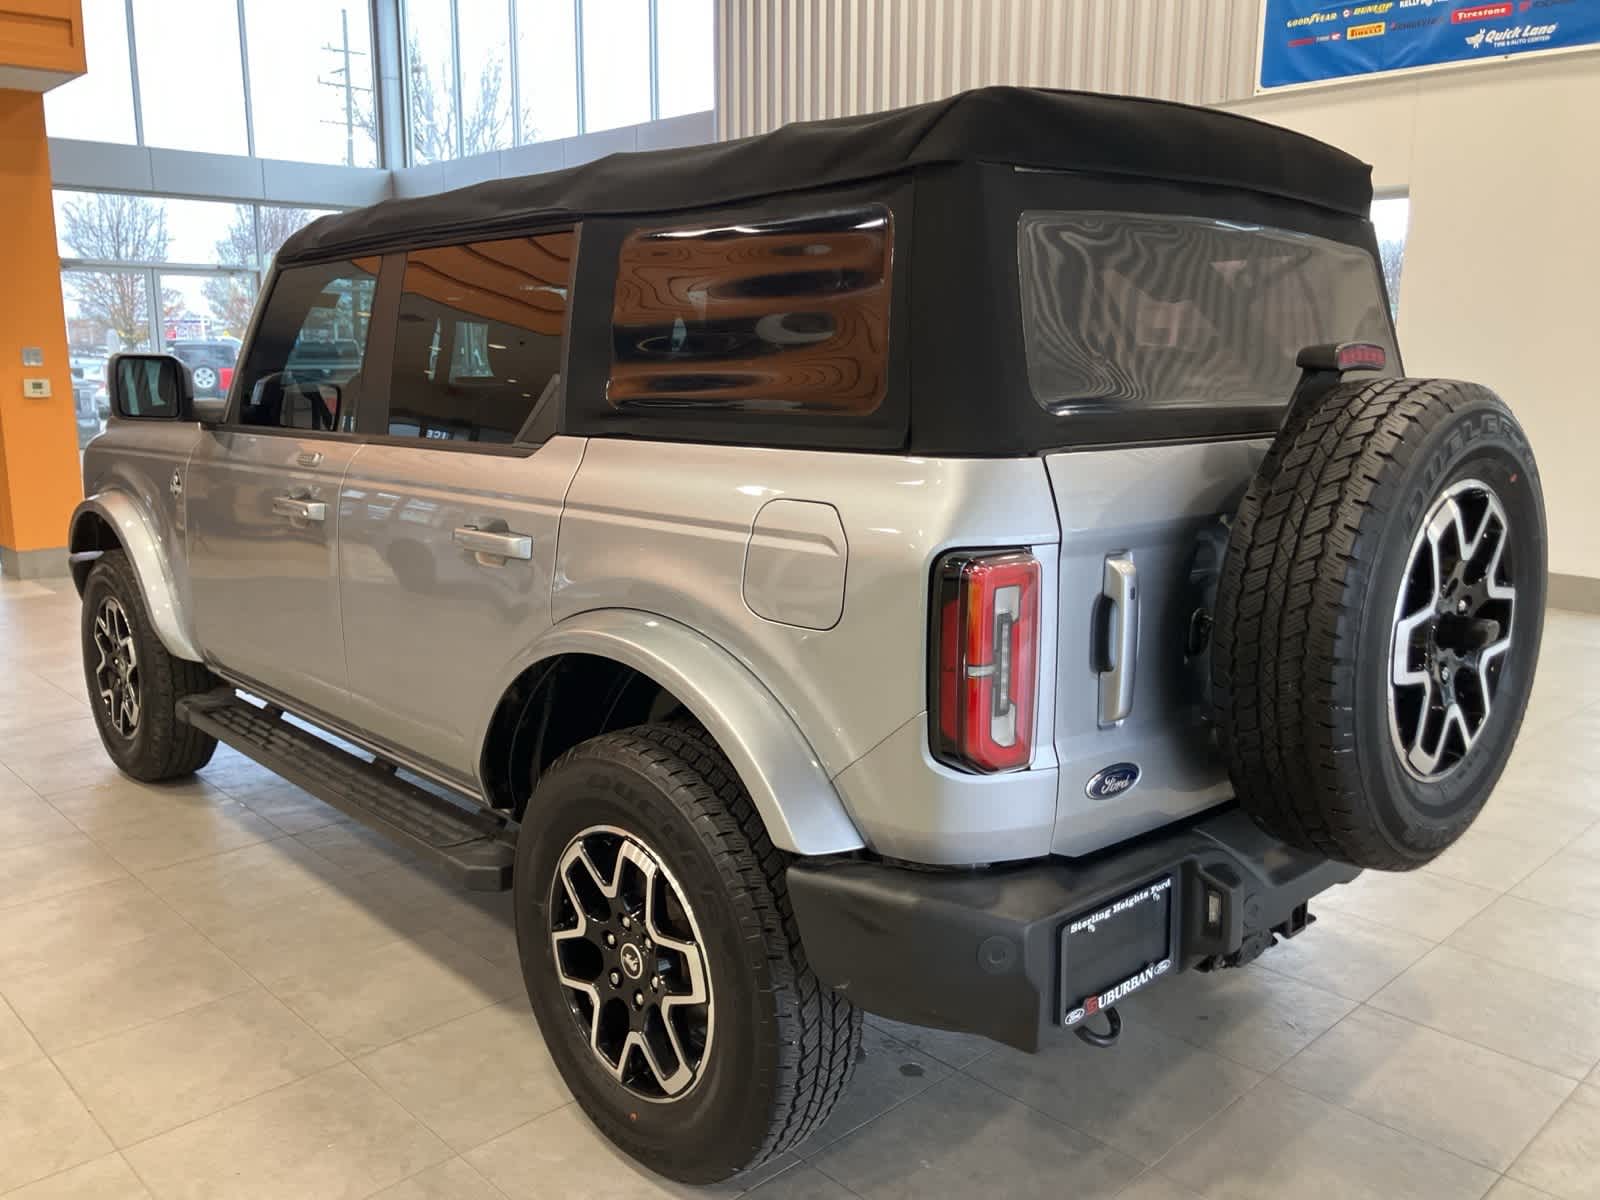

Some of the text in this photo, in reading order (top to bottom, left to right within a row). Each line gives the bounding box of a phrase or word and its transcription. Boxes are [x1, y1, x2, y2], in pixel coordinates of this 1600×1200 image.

[1353, 2, 1393, 16] DUNLOP
[1457, 7, 1507, 21] Firestone
[1286, 12, 1337, 28] GOODYEAR
[1485, 23, 1556, 43] Quick Lane
[1100, 774, 1130, 795] Ford
[1071, 878, 1171, 934] Sterling Heights Ford
[1086, 965, 1154, 1015] SUBURBAN
